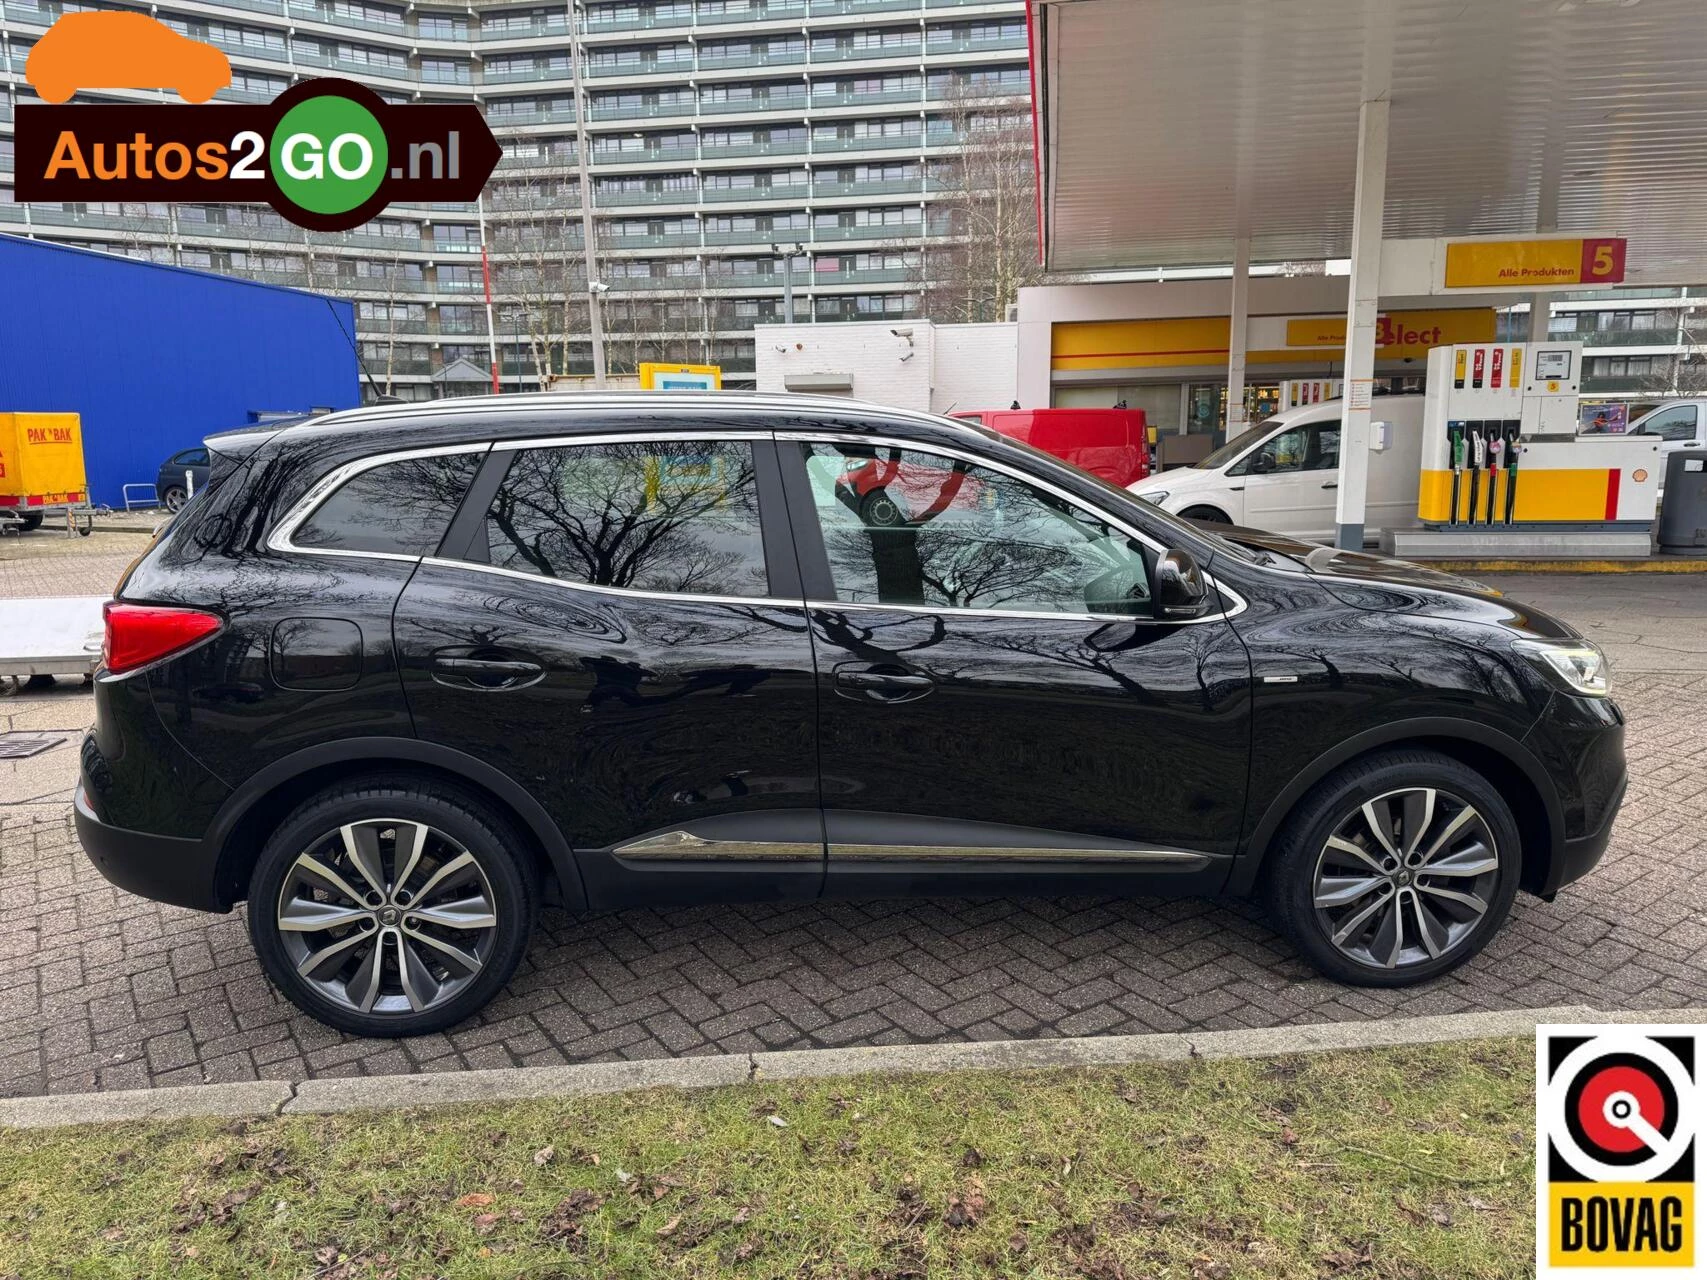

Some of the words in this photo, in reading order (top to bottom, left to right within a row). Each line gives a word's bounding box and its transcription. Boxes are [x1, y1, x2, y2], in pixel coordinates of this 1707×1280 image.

[1592, 246, 1614, 275] 5
[1498, 268, 1519, 278] Alle
[1521, 267, 1575, 277] Produkten
[27, 428, 46, 441] PAK
[54, 428, 72, 440] BAK
